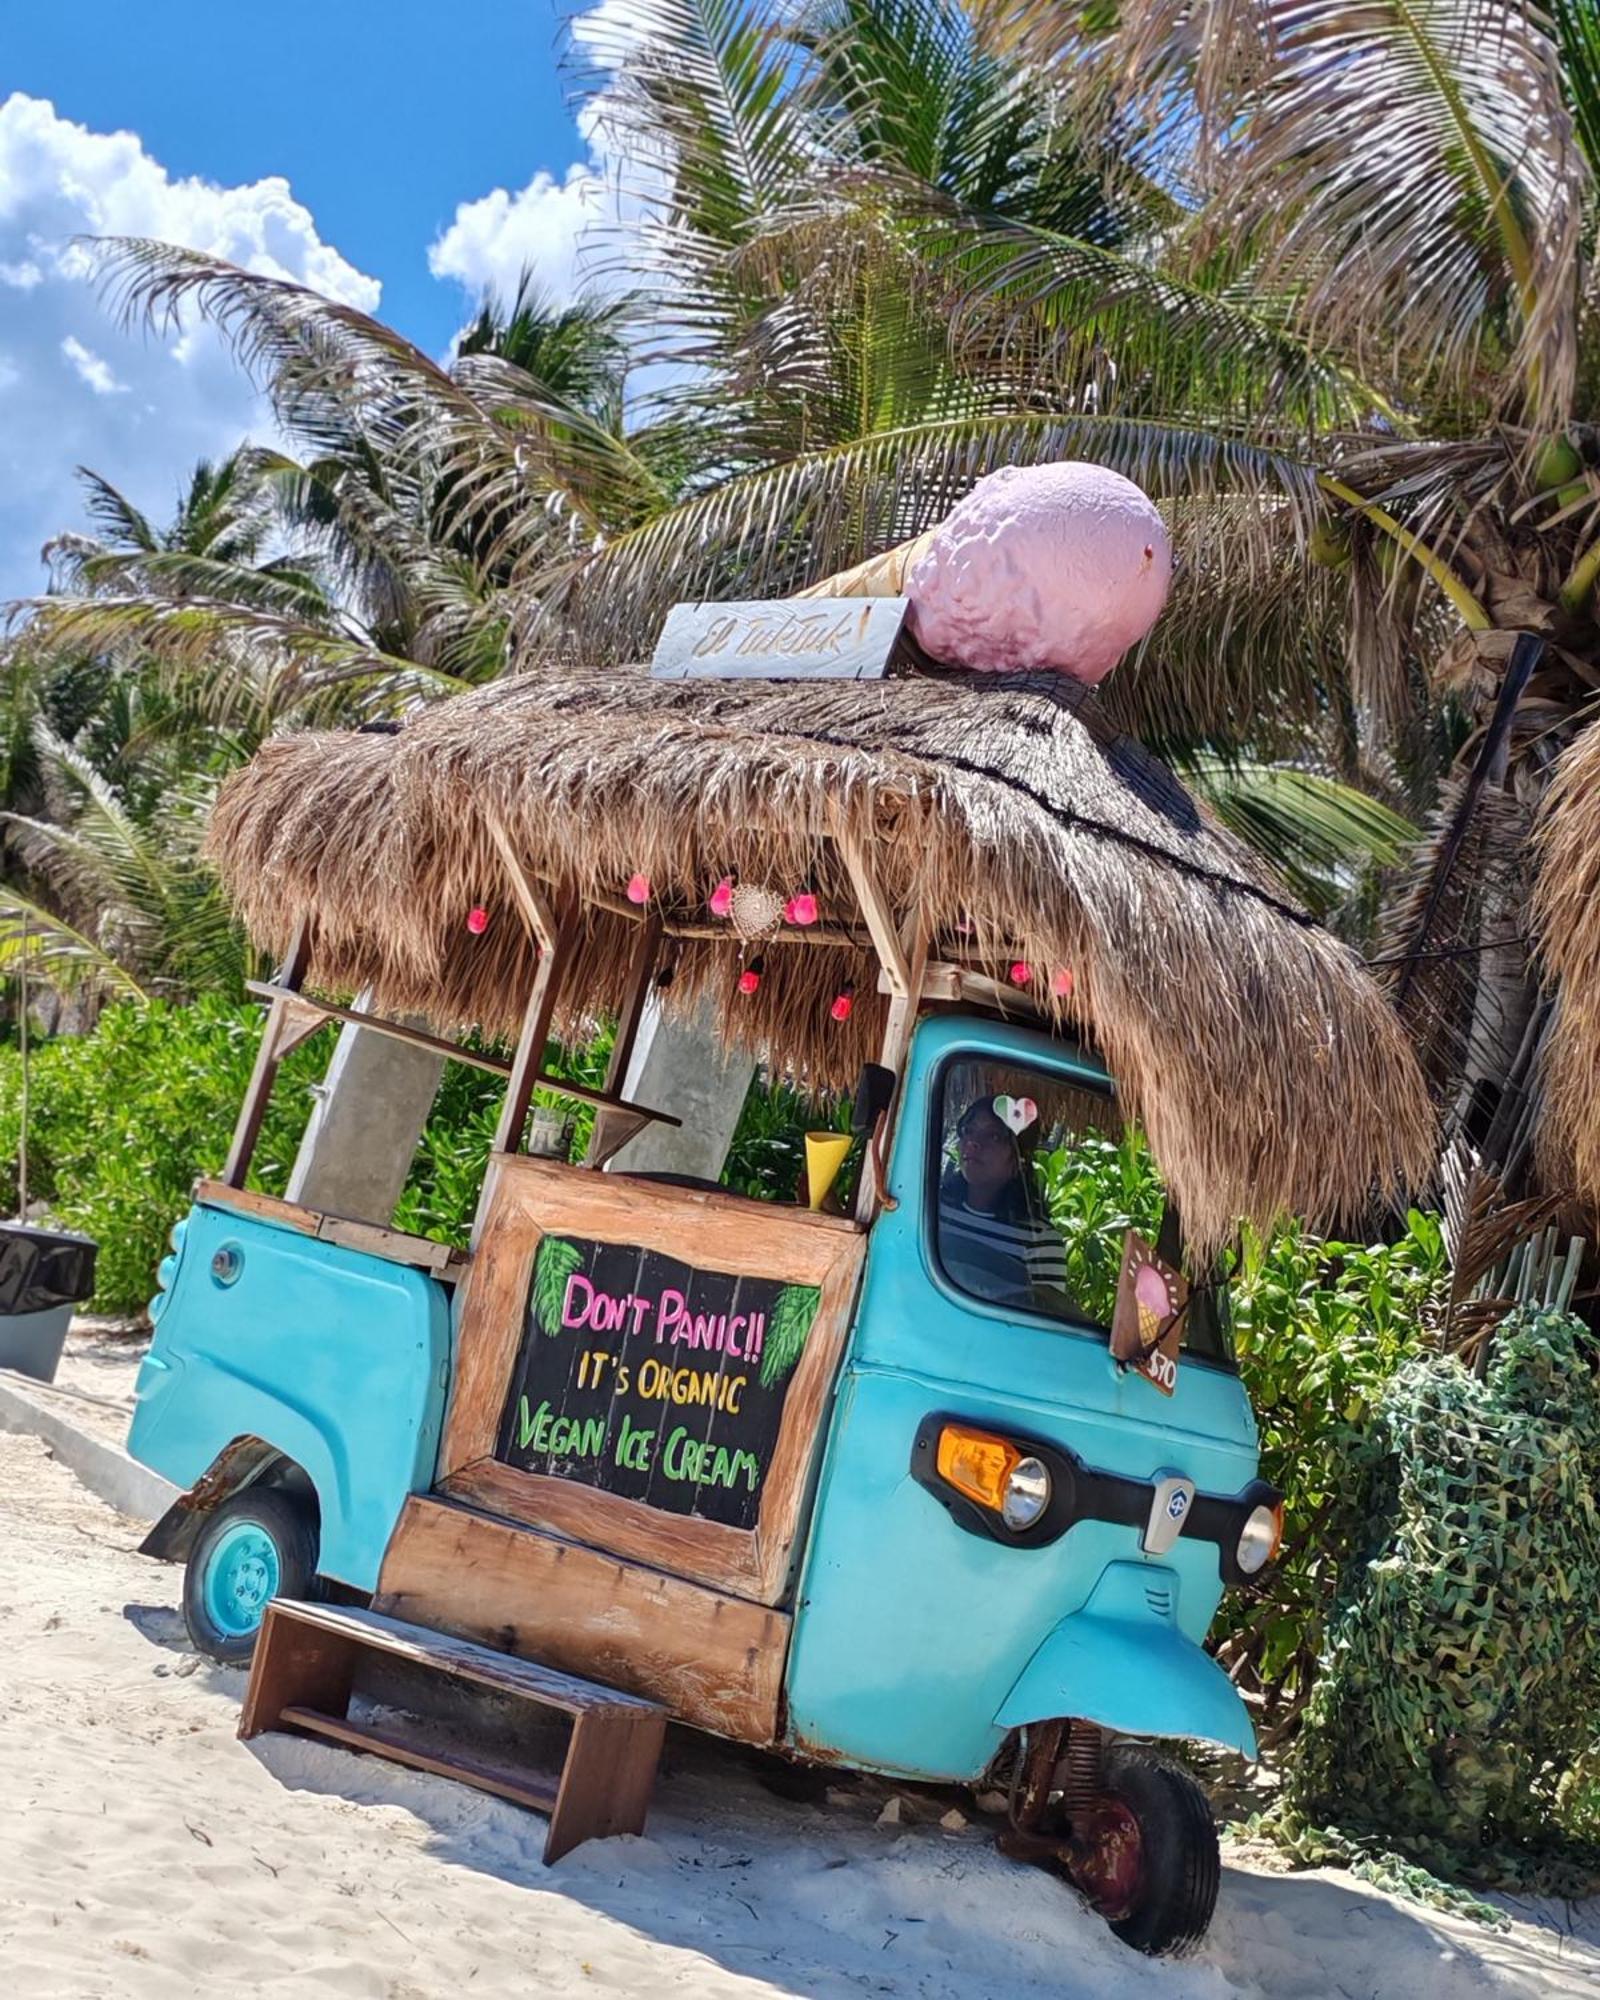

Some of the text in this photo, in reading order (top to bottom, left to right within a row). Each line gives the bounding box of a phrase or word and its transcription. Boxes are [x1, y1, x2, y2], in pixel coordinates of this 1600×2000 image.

[561, 1273, 765, 1364] DON'T PANIC!!
[637, 1358, 747, 1414] ORGANIC
[1147, 1348, 1177, 1388] $70
[517, 1395, 761, 1491] VEGAN ICE CREAM
